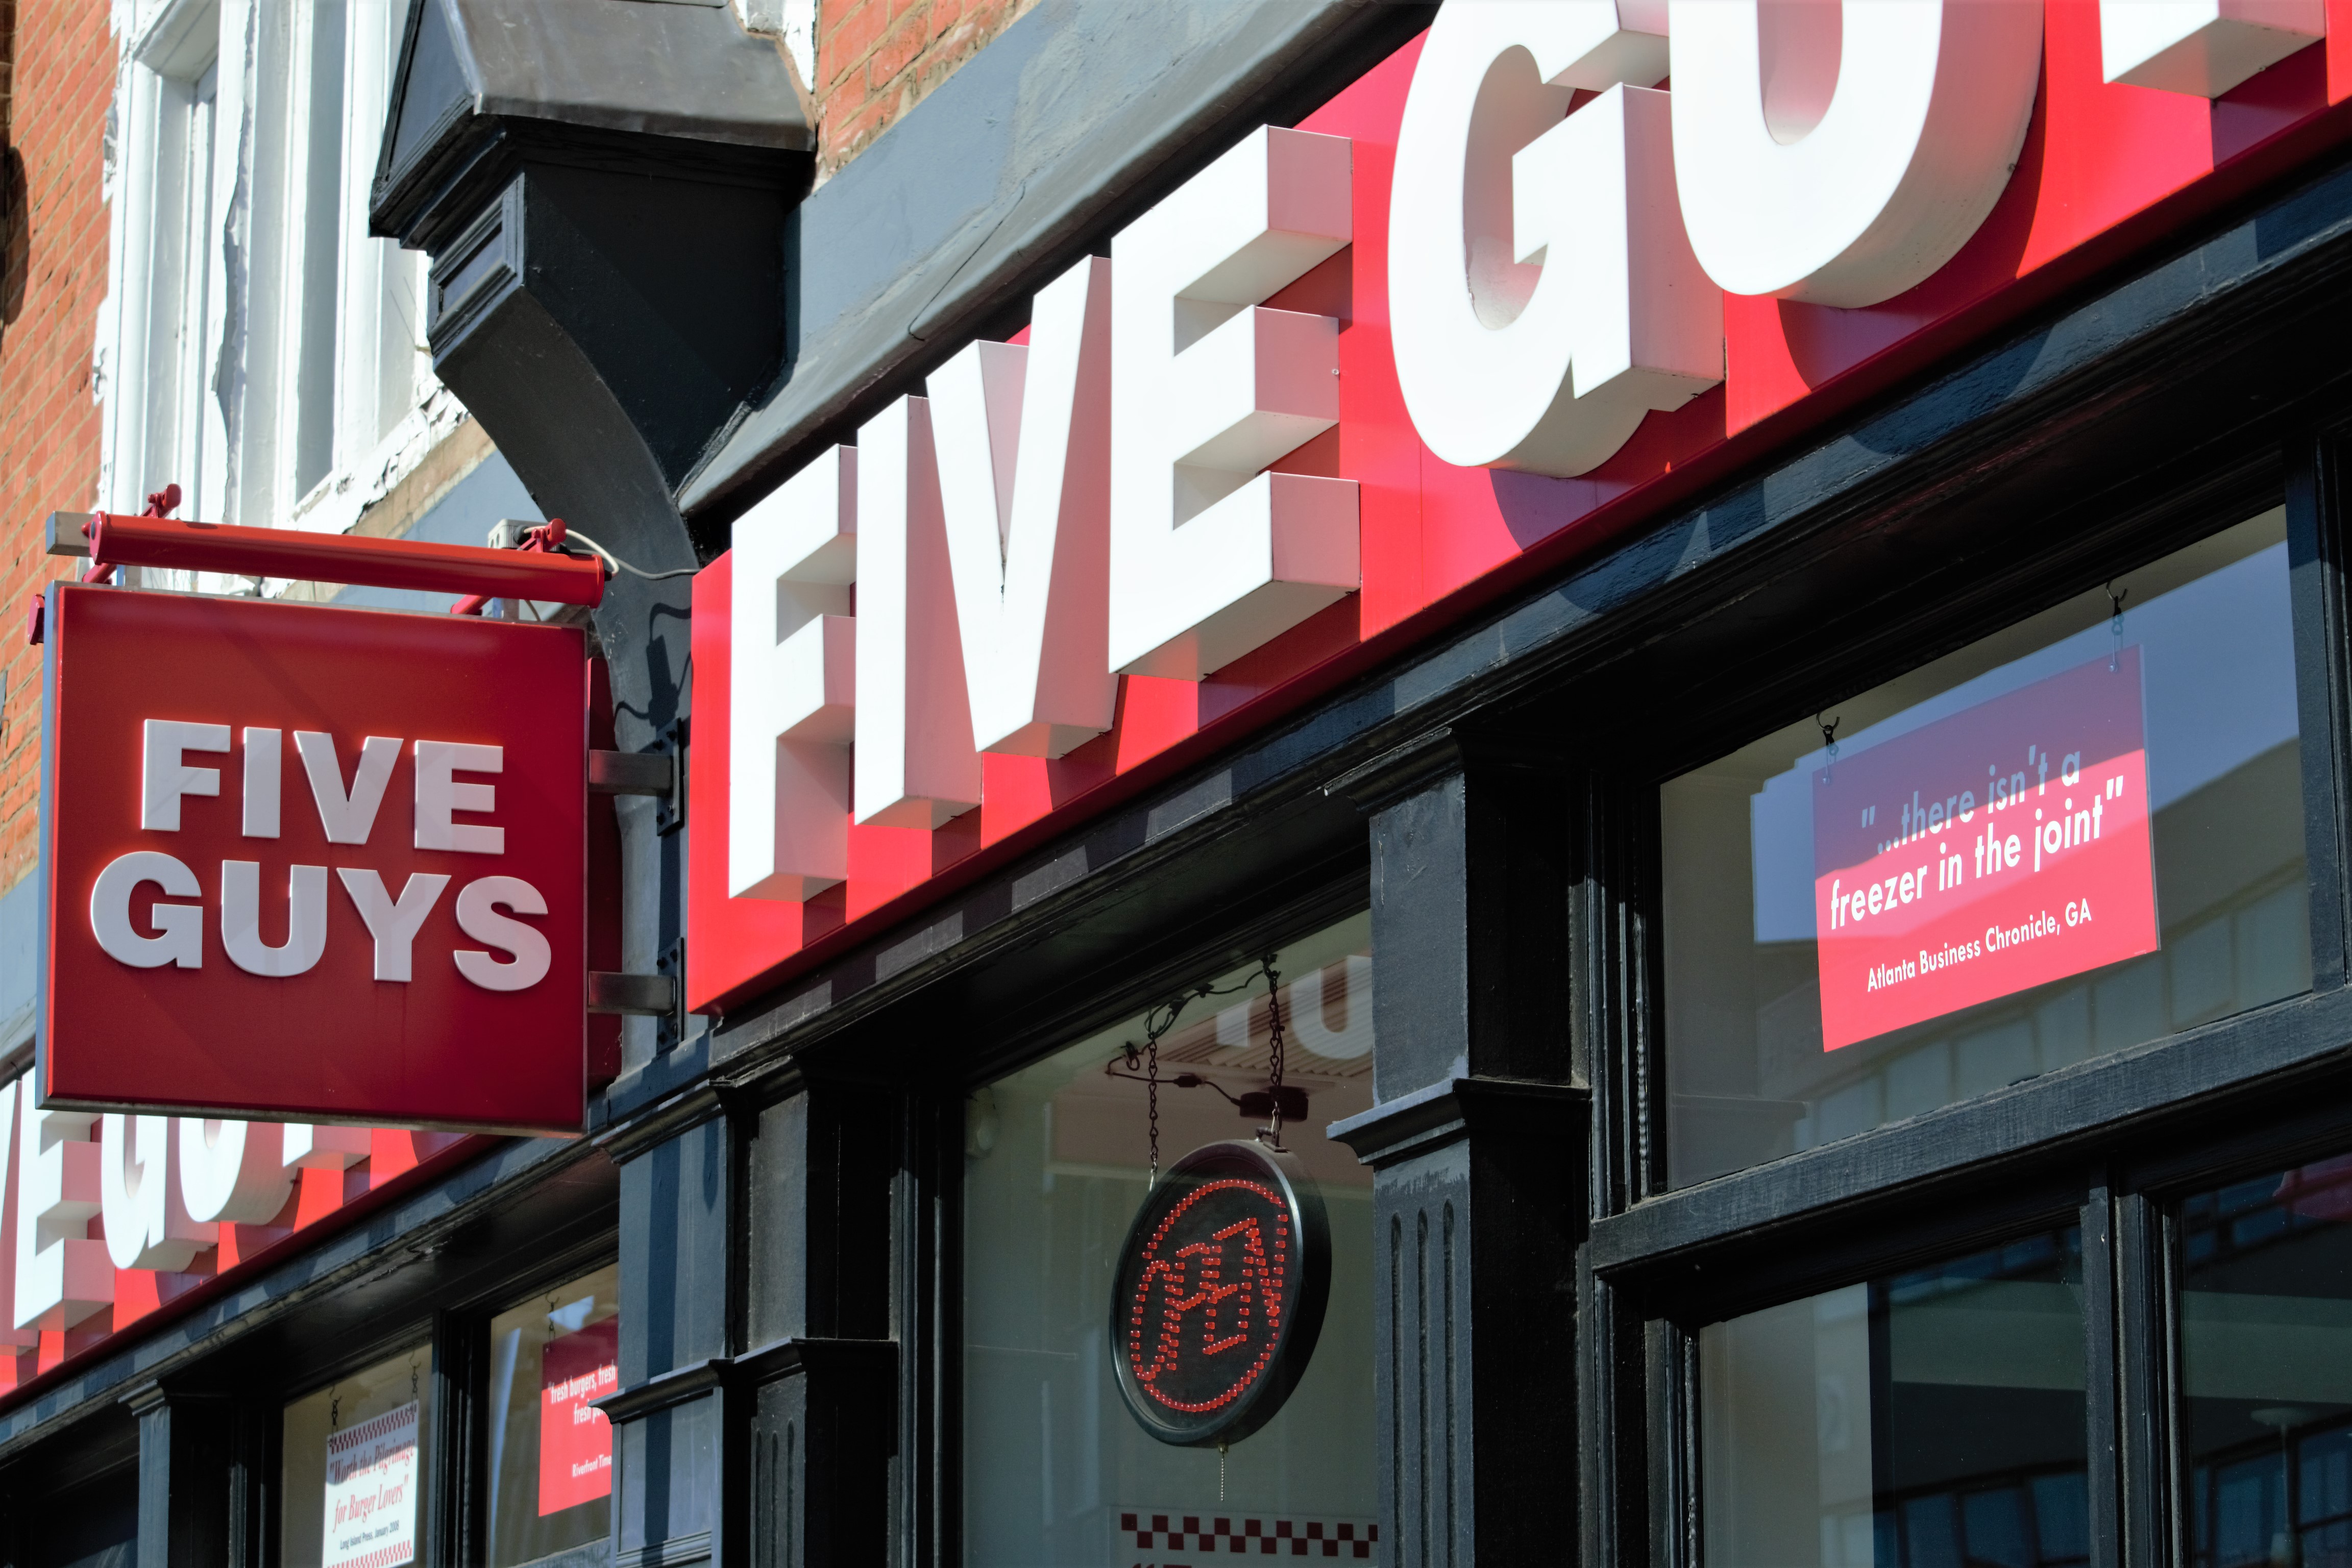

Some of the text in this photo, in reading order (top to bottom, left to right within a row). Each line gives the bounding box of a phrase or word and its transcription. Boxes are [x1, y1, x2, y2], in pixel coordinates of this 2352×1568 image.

[730, 0, 2219, 899] FIVE GU
[142, 718, 505, 855] FIVE
[1988, 744, 2048, 814] isn't
[2061, 751, 2080, 787] a
[1830, 775, 2124, 930] freezer in the joint"
[90, 851, 552, 991] GUYS
[1867, 898, 2092, 993] Atlanta Business Chronicle, GA
[1130, 1204, 1288, 1381] OPEN
[548, 1359, 616, 1404] "fresh burgers, fresh
[574, 1399, 592, 1425] fresh
[330, 1437, 415, 1484] "Worth the Pilgrimage
[572, 1457, 598, 1478] Riverfront
[333, 1473, 409, 1533] for Burger Lovers"
[340, 1539, 350, 1550] Long
[350, 1533, 362, 1547] Island
